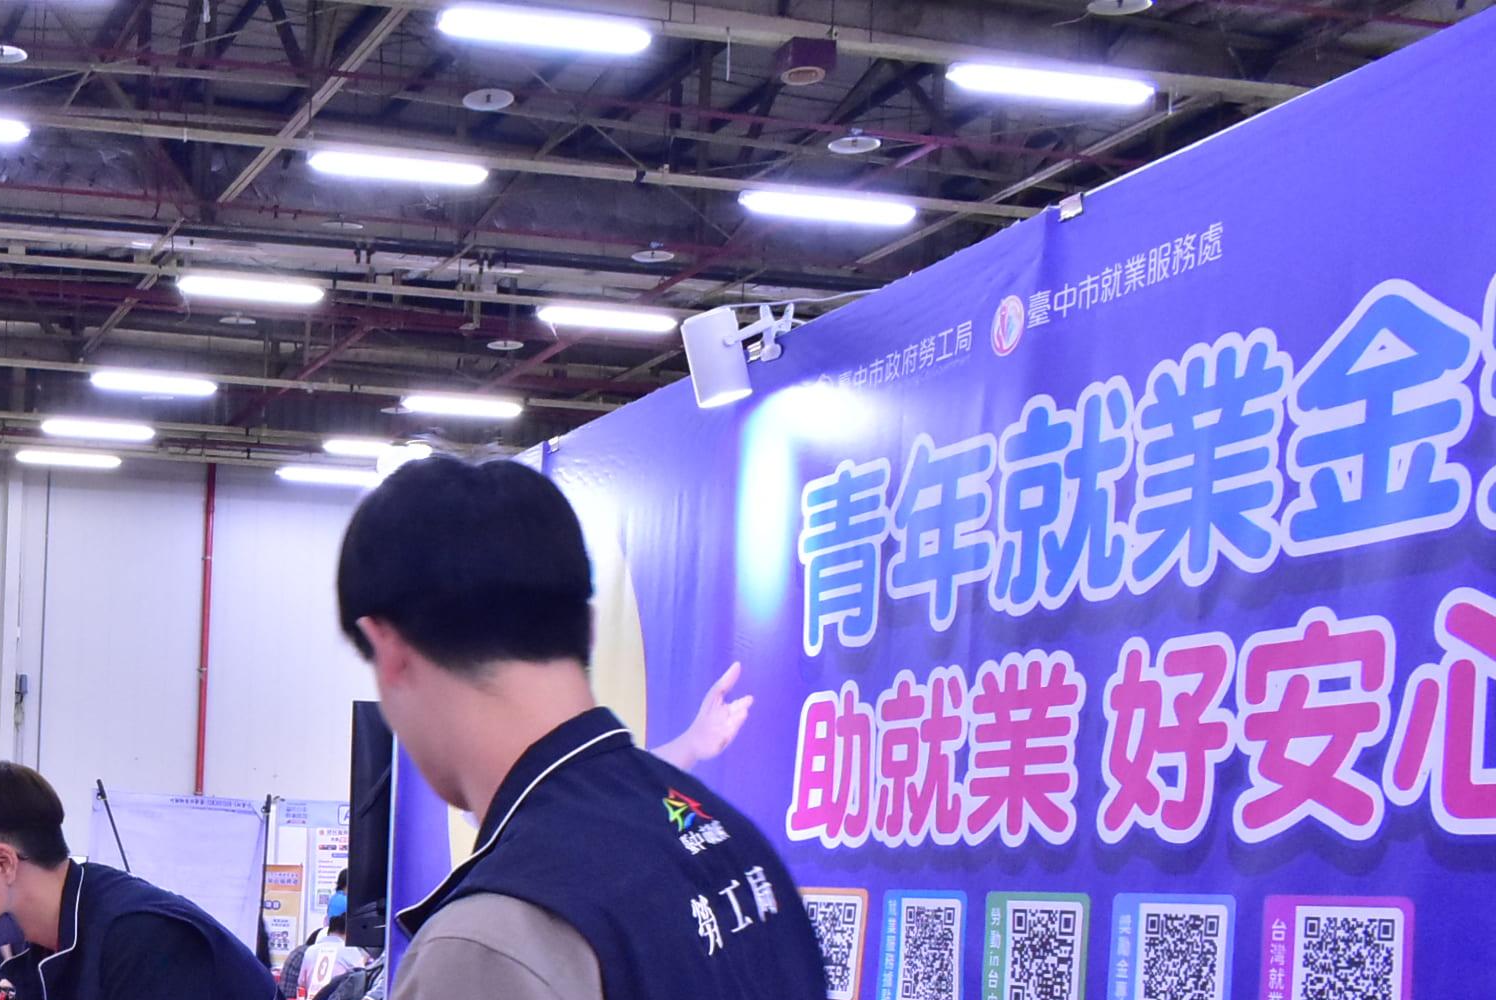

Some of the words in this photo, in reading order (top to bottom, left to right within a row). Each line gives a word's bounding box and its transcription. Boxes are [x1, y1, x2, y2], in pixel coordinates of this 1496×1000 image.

[1026, 222, 1224, 329] 臺中市就業服務處
[799, 270, 1496, 656] 青年就業金
[786, 649, 1086, 848] 助就業
[1097, 587, 1496, 843] 好安心
[689, 865, 779, 956] 勞工局
